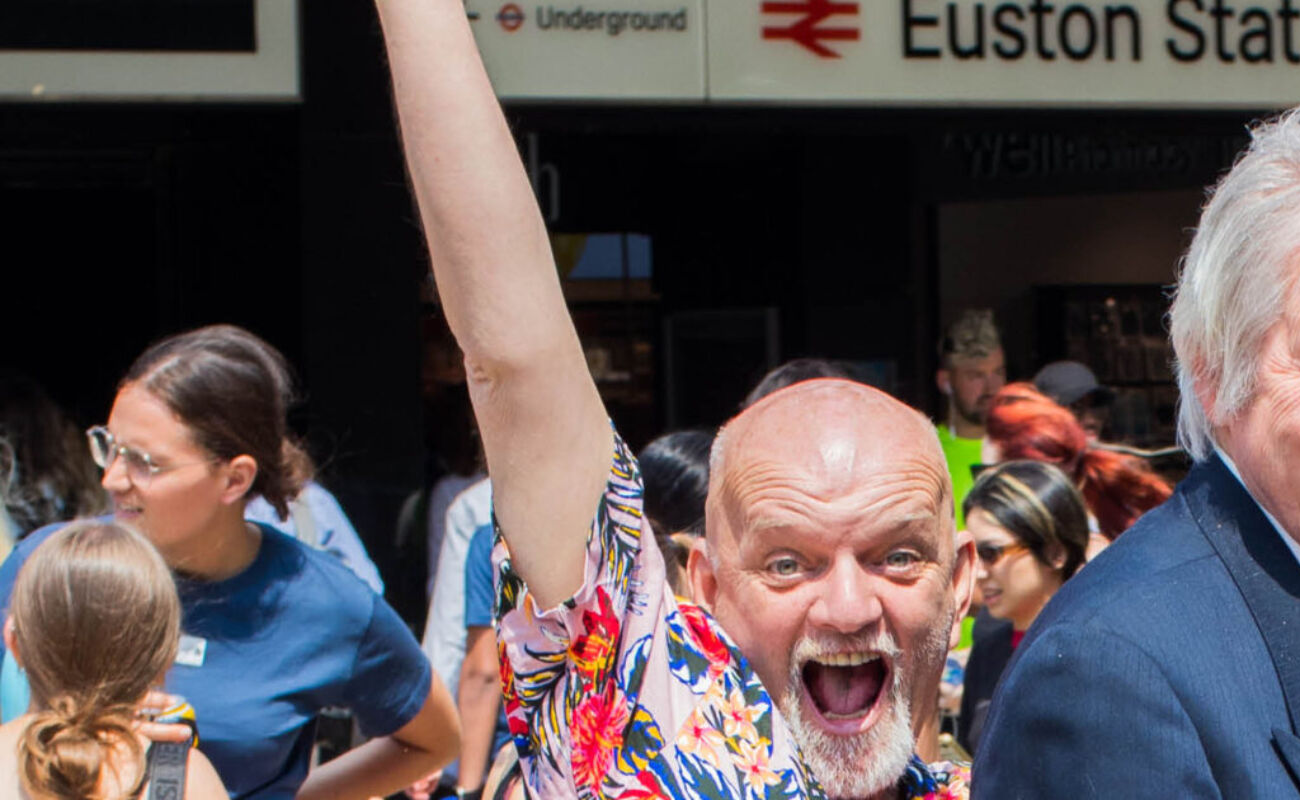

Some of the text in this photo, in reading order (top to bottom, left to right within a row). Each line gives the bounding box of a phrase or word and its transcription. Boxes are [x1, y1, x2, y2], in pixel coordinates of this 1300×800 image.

[536, 6, 687, 36] Underground
[903, 0, 1142, 61] Euston
[155, 778, 179, 800] IS
